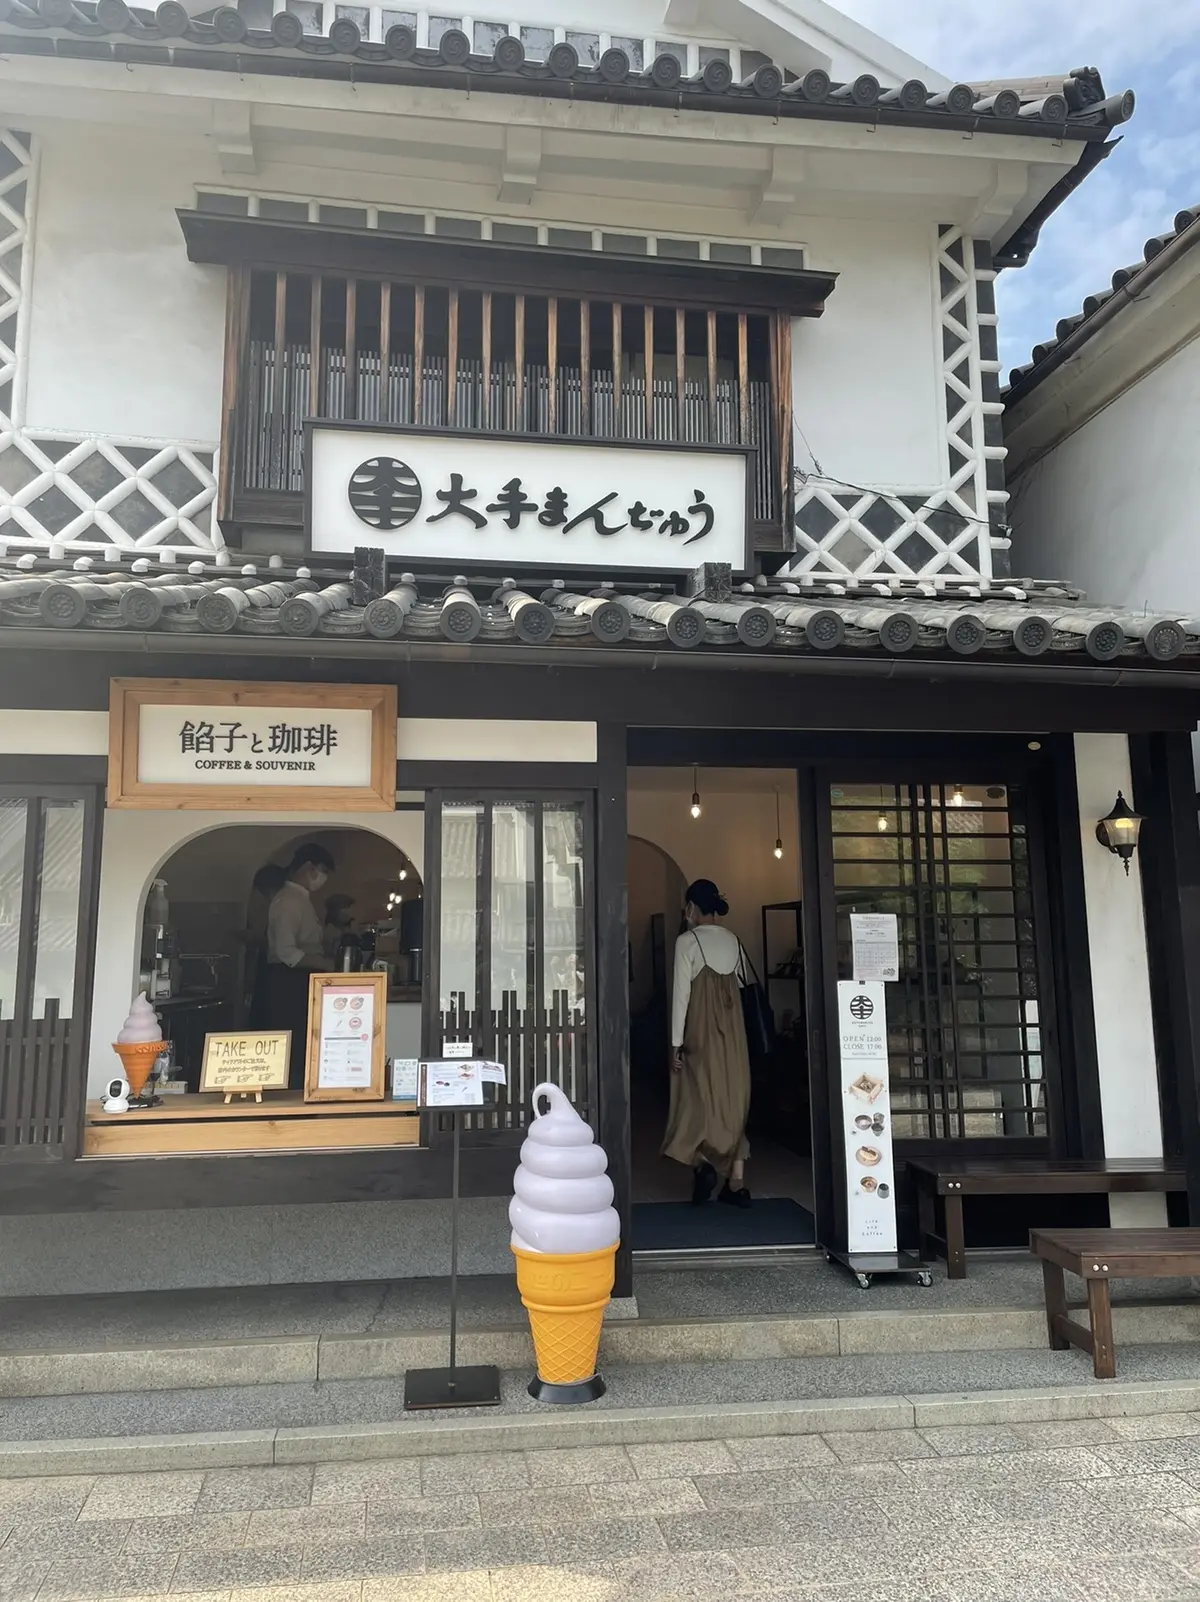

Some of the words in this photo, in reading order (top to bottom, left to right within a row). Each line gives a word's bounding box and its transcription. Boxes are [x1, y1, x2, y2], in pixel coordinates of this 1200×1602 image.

[425, 472, 716, 547] 大手まんぢゅう
[179, 720, 339, 756] 餡子と珈琲
[195, 760, 242, 770] COFFEE
[243, 760, 253, 771] &
[255, 760, 316, 771] SOUVENIR
[215, 1041, 247, 1057] TAKE
[255, 1040, 279, 1056] OUT
